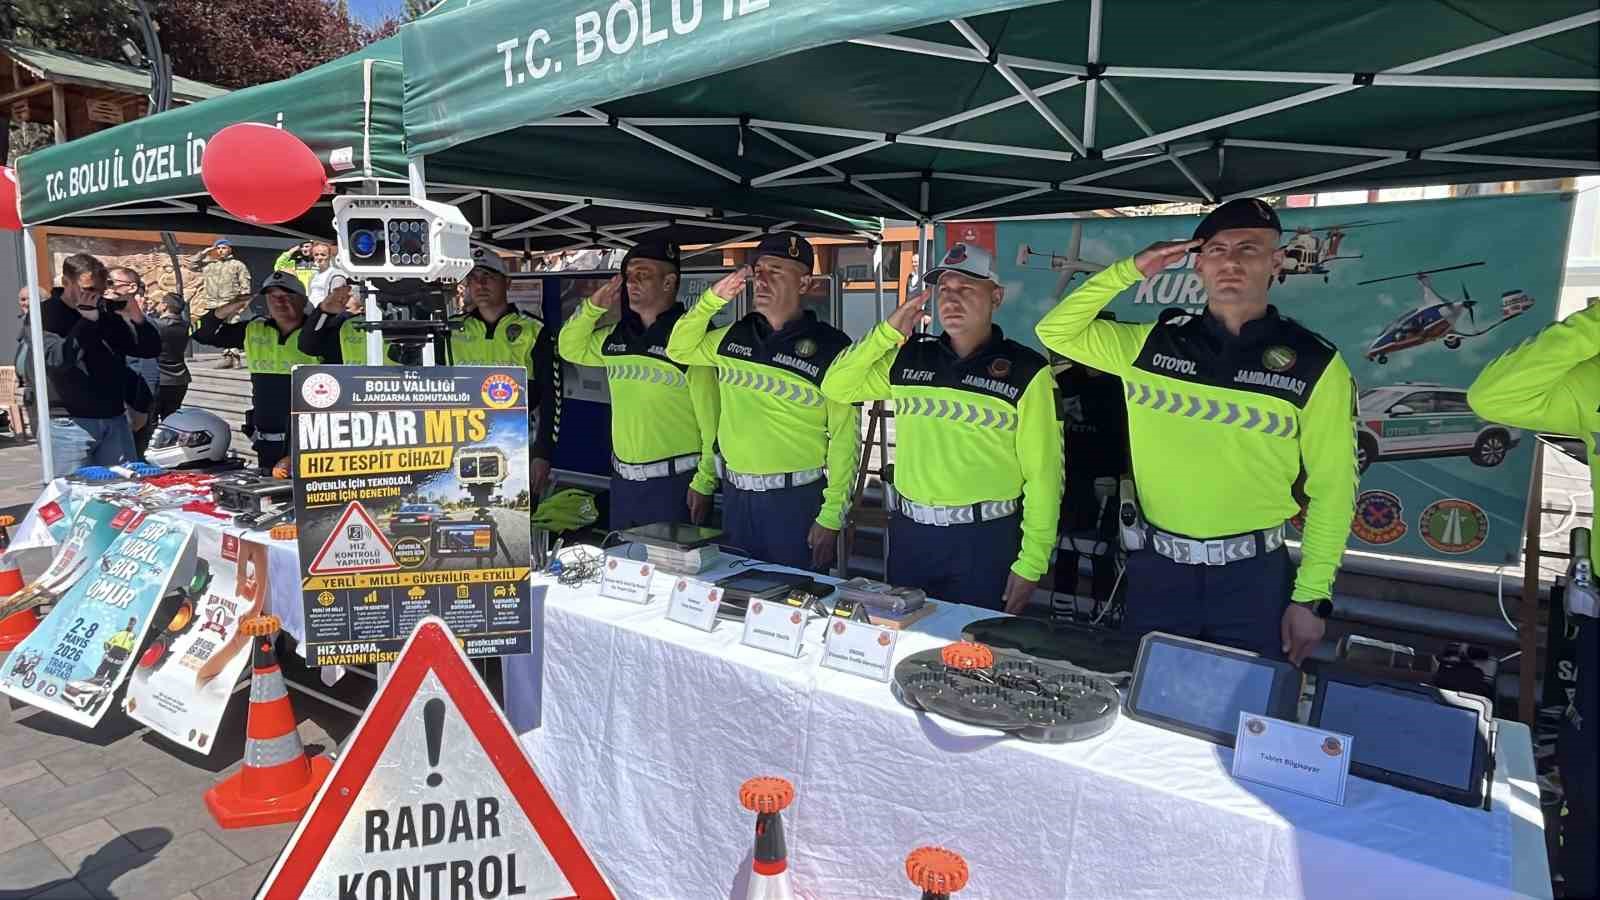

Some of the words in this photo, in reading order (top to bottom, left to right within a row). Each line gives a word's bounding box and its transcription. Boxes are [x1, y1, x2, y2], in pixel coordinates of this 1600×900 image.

[496, 29, 562, 88] T.C.
[575, 0, 703, 66] BOLU
[46, 170, 67, 202] T.C.
[69, 158, 110, 197] BOLU
[113, 148, 129, 188] İL
[132, 144, 182, 184] ÖZEL
[1134, 273, 1209, 304] KUR
[1152, 353, 1197, 375] OTOYOL
[1234, 370, 1307, 395] JANDARMASI
[365, 380, 401, 393] BOLU
[403, 378, 455, 392] VALİLİĞİ
[961, 374, 1019, 399] JANDARMASI
[352, 393, 362, 402] İL
[363, 393, 411, 402] JANDARMA
[412, 391, 470, 402] KOMUTANLIĞI
[298, 410, 417, 450] MEDAR
[425, 409, 486, 444] MTS
[308, 456, 335, 474] HIZ
[339, 451, 393, 472] TESPİT
[398, 449, 445, 469] CİHAZI
[306, 478, 347, 492] GÜVENLİK
[349, 478, 366, 490] İÇİN
[367, 475, 413, 487] TEKNOLOJİ,
[307, 492, 337, 503] HUZUR
[339, 490, 358, 502] İÇİN
[360, 487, 402, 500] DENETİM!
[107, 559, 139, 581] BİR
[322, 573, 356, 588] YERLİ
[370, 572, 401, 586] MİLLİ
[412, 571, 470, 584] GÜVENİLİR
[482, 568, 517, 581] ETKİLİ
[70, 617, 99, 638] 2-8
[62, 632, 91, 648] MAYIS
[317, 645, 336, 656] HIZ
[338, 643, 380, 654] YAPMA,
[54, 643, 84, 662] 2026
[318, 654, 367, 665] HAYATINI
[1260, 752, 1283, 764] Tablet
[365, 797, 501, 853] RADAR
[338, 853, 526, 900] KONTROL
